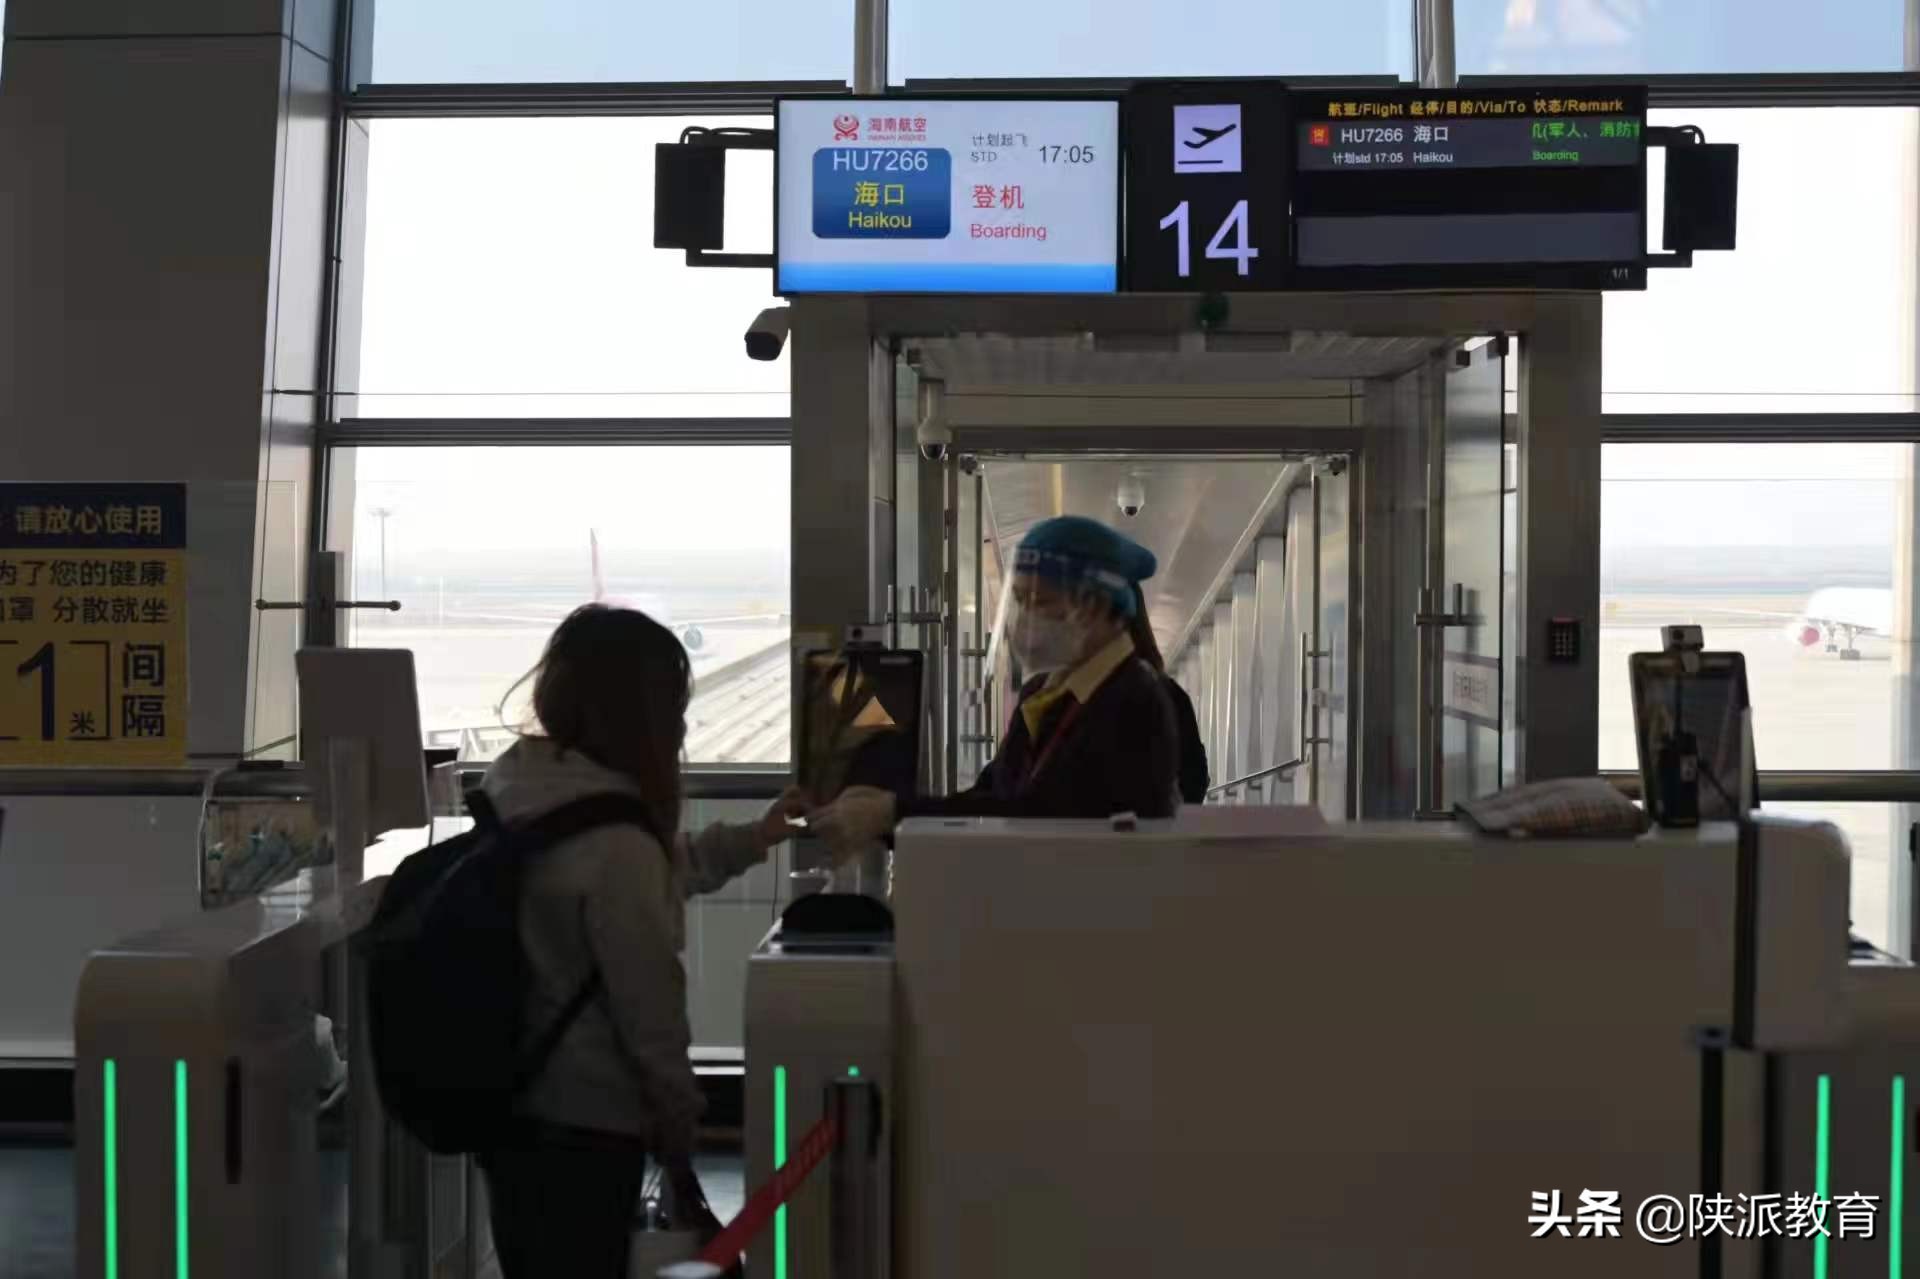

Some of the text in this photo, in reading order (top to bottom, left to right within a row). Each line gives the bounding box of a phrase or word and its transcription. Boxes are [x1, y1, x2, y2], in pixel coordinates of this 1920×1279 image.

[972, 133, 1028, 147] 计划起飞
[1341, 125, 1449, 143] HU7266 海口
[833, 150, 928, 171] HU7266
[970, 151, 997, 162] STD
[1039, 145, 1094, 163] 17:05
[1413, 152, 1453, 163] Haikou
[1533, 150, 1579, 161] Boarding
[854, 182, 905, 207] 海口
[972, 185, 1024, 209] 登机
[848, 211, 912, 229] Haikou
[970, 223, 1047, 241] Boarding
[1159, 200, 1259, 277] 14
[16, 504, 162, 535] 请放心使用
[53, 597, 168, 624] 分散就坐
[17, 641, 95, 741] 1 米
[122, 643, 165, 738] 间隔
